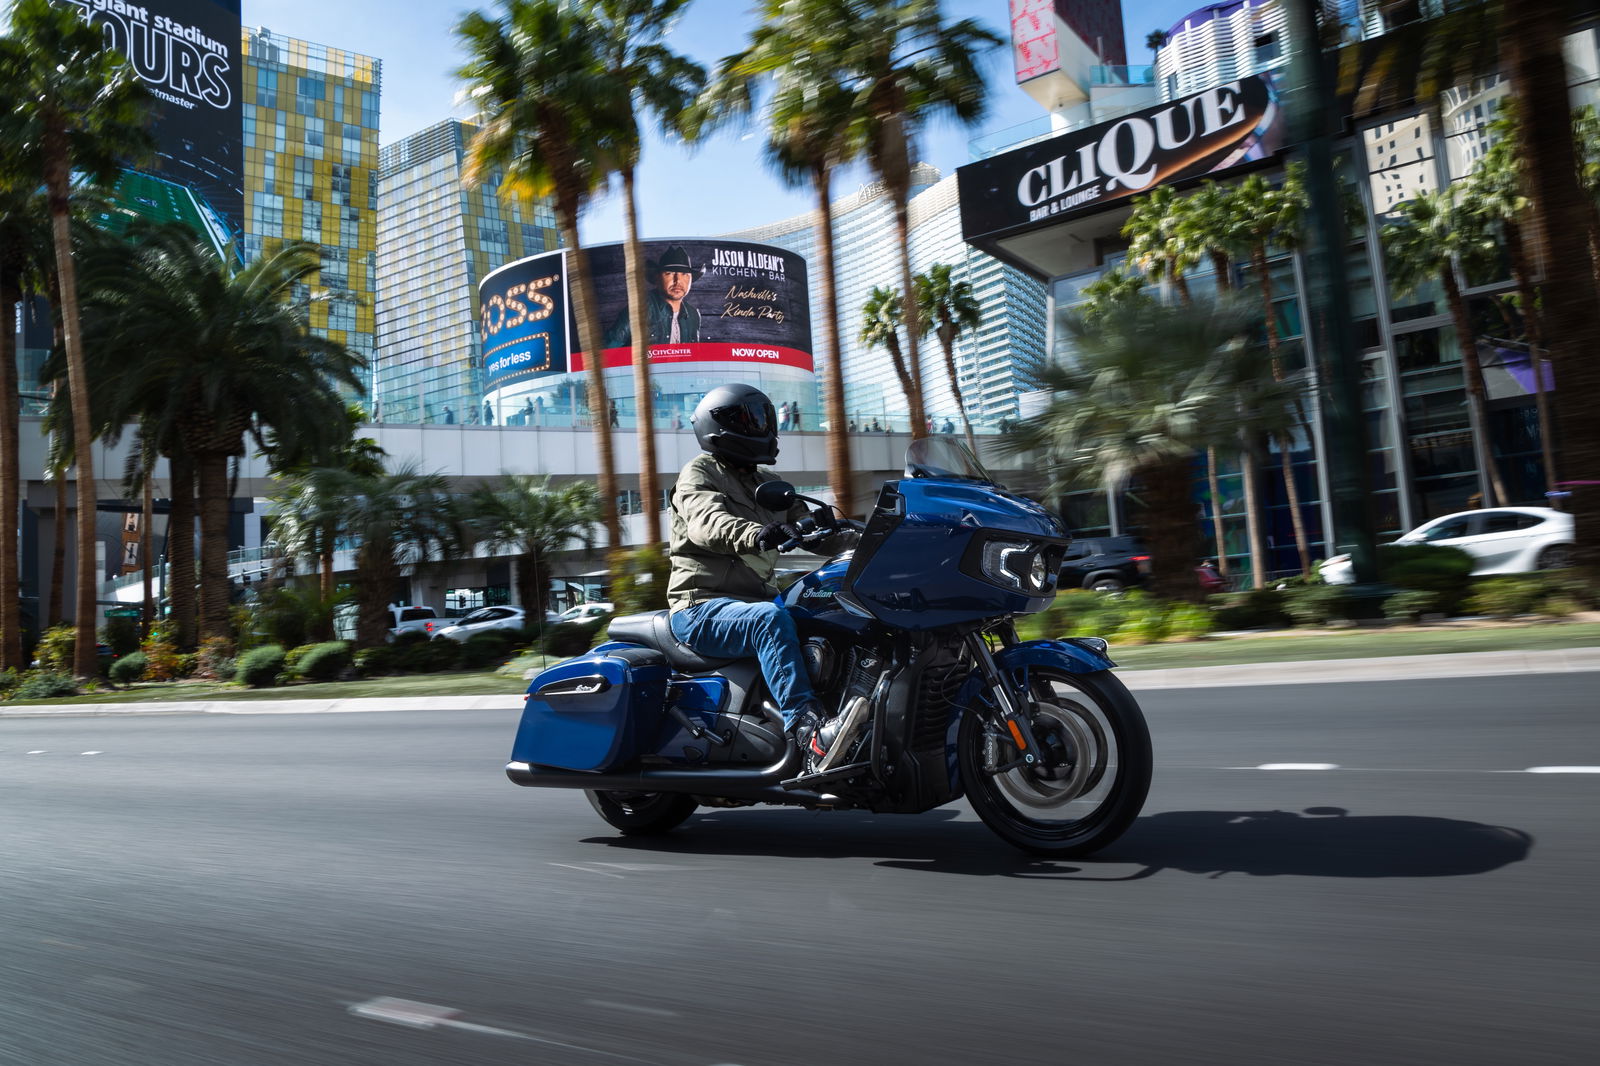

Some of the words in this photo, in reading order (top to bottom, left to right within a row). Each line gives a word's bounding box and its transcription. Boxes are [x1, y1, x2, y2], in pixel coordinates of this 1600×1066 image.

[154, 15, 228, 58] stadium
[66, 0, 230, 109] OURS
[1017, 82, 1246, 207] CLIQUE
[1029, 205, 1049, 222] BAR
[1050, 201, 1060, 214] &
[1060, 184, 1101, 211] LOUNGE
[712, 248, 744, 267] JASON
[747, 250, 784, 273] ALDEAN'S
[712, 266, 757, 277] KITCHEN
[769, 271, 785, 281] BAR
[725, 285, 777, 301] Nashville's
[720, 302, 755, 318] Kinda
[758, 305, 784, 324] Party
[489, 361, 499, 376] yes
[500, 357, 510, 368] for
[511, 351, 531, 365] less
[732, 348, 756, 357] NOW
[756, 349, 779, 359] OPEN
[803, 588, 832, 598] Indian
